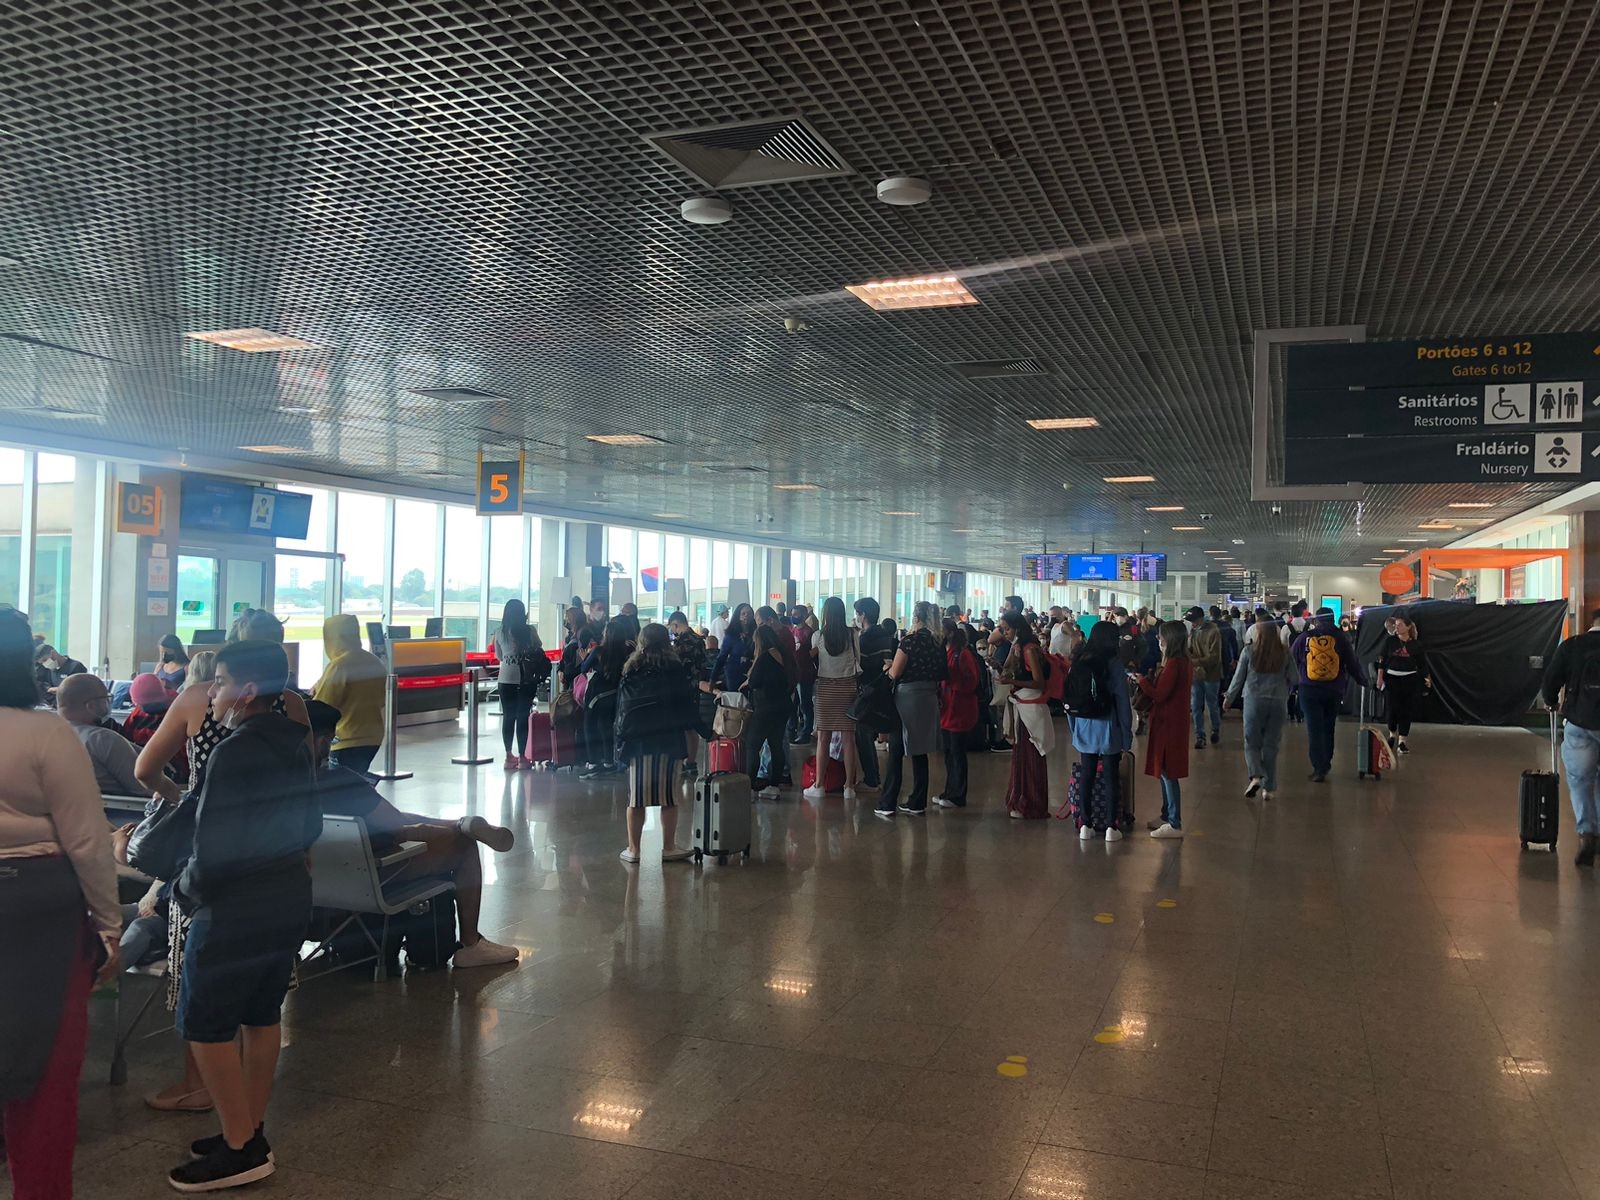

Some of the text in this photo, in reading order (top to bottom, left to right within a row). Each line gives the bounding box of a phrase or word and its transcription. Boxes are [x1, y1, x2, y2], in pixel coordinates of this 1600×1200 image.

[1417, 342, 1532, 359] Portões 6 a 12
[1452, 365, 1487, 376] Gates
[1491, 364, 1499, 375] 6
[1398, 393, 1478, 409] Sanitários
[1414, 415, 1478, 427] Restrooms
[1456, 441, 1530, 456] Fraldário
[1480, 463, 1529, 477] Nursery
[490, 474, 509, 504] 5
[128, 494, 154, 516] 05
